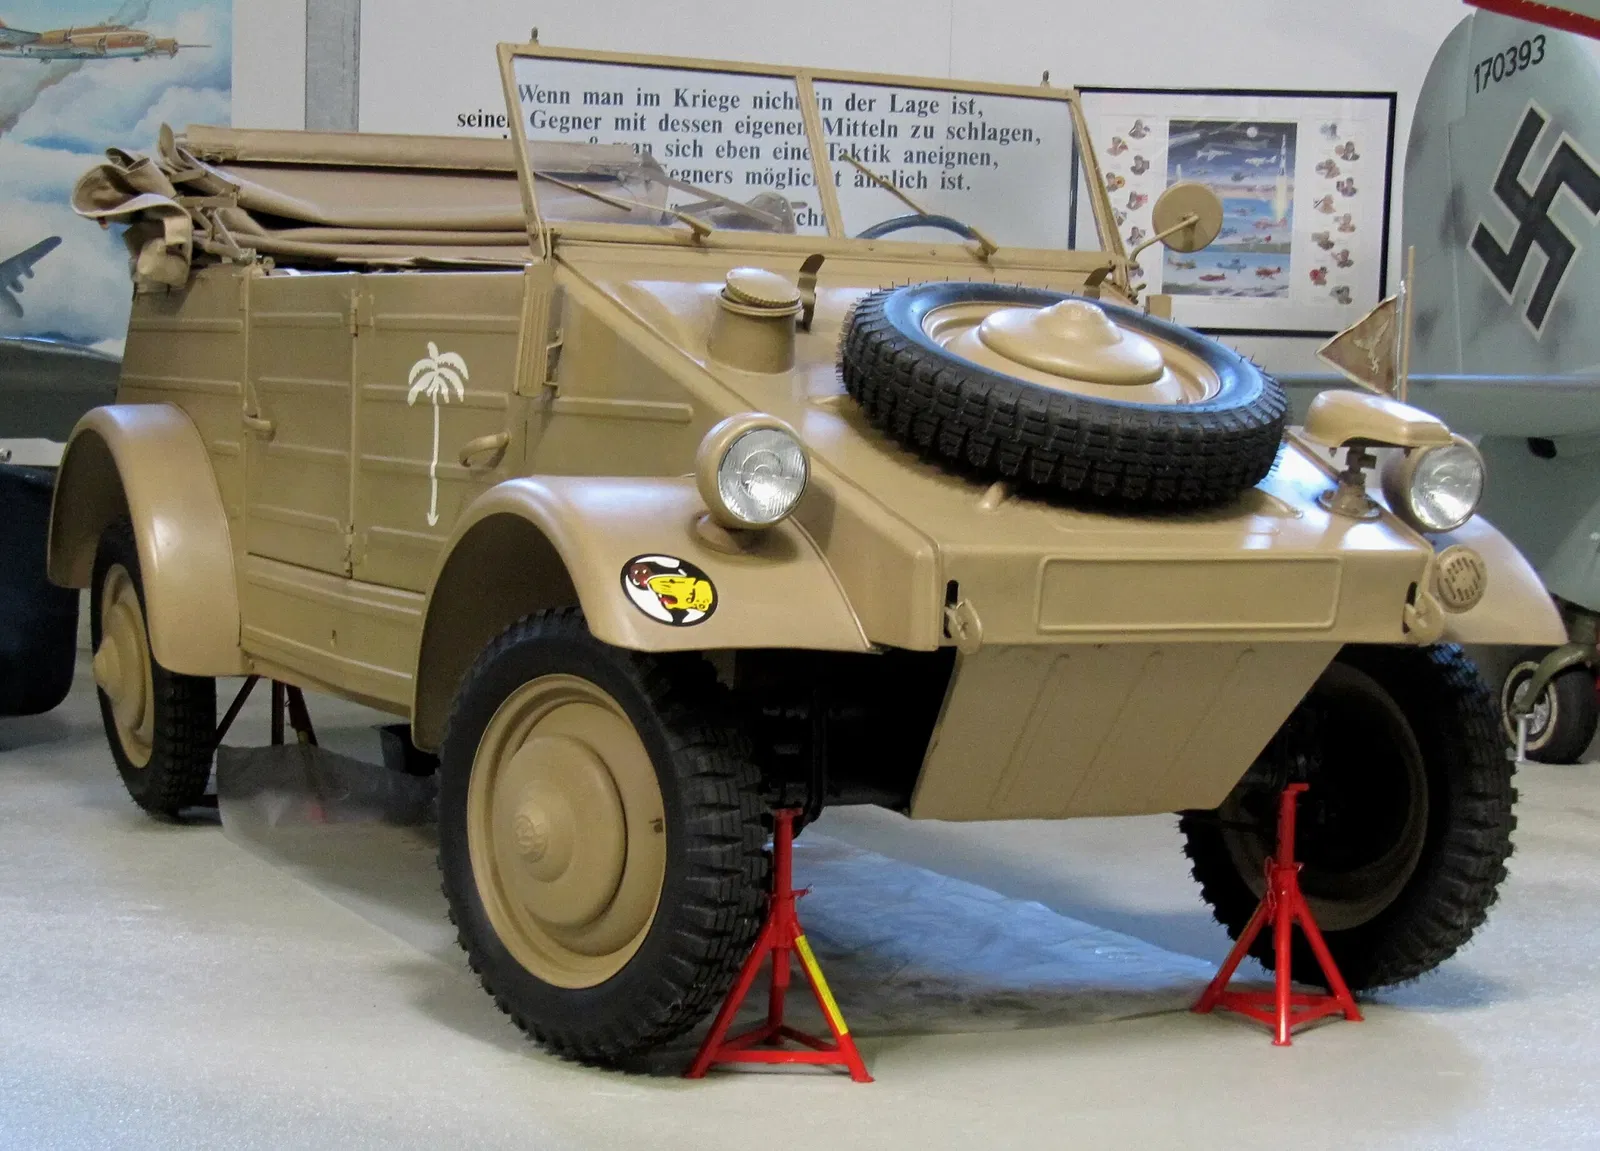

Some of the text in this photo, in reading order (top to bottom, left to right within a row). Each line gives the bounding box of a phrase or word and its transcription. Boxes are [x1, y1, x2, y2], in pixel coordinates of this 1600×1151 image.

[1474, 34, 1546, 94] 170393
[518, 83, 570, 105] Wenn
[582, 90, 624, 106] man
[636, 87, 660, 107] im
[674, 87, 740, 113] Kriege
[815, 91, 833, 111] in
[845, 92, 877, 112] der
[889, 93, 940, 118] Lage
[951, 95, 983, 118] ist,
[529, 109, 602, 134] Gegner
[614, 112, 647, 132] mit
[658, 113, 723, 134] dessen
[822, 117, 898, 140] Mitteln
[911, 124, 935, 139] zu
[946, 121, 1042, 146] schlagen,
[664, 138, 704, 158] sich
[715, 139, 761, 160] eben
[825, 142, 891, 163] Taktik
[903, 145, 999, 170] aneignen,
[660, 163, 734, 185] egners
[745, 167, 842, 190] möglict
[940, 171, 971, 191] ist.
